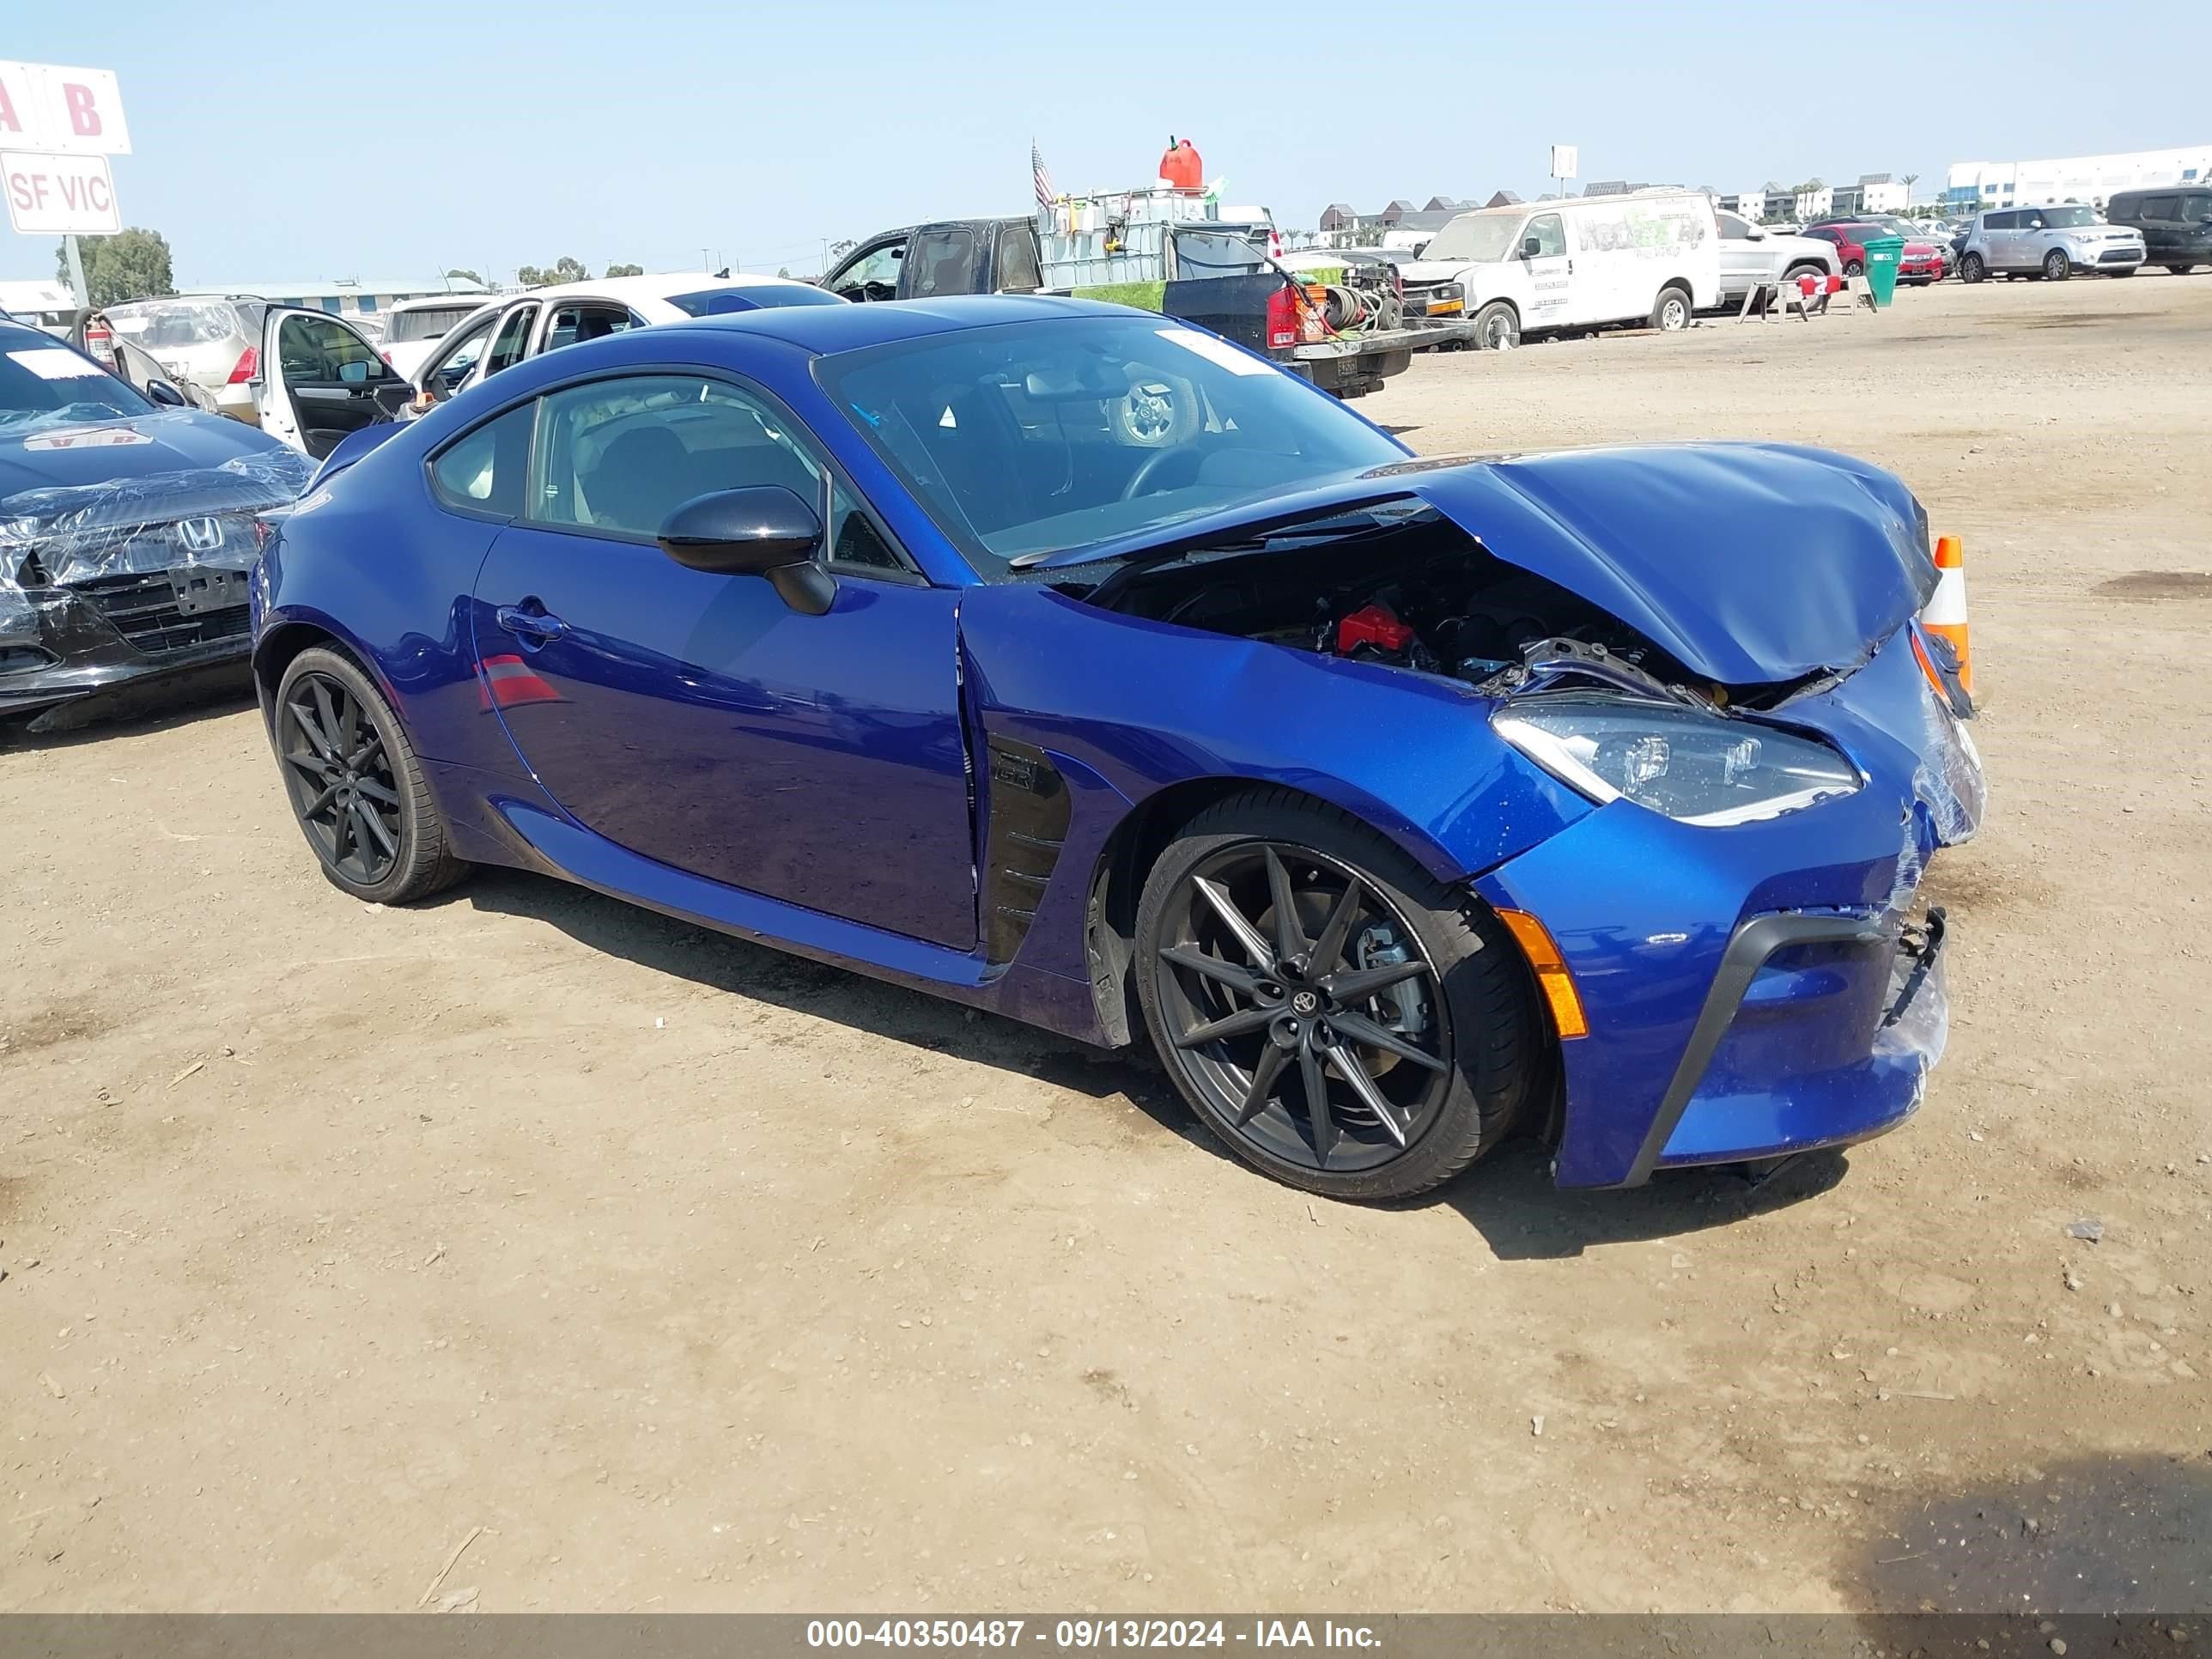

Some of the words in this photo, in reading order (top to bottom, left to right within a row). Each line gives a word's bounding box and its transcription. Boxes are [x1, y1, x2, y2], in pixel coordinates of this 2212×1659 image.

[63, 82, 102, 136] B
[10, 173, 49, 210] SF
[57, 175, 110, 212] VIC
